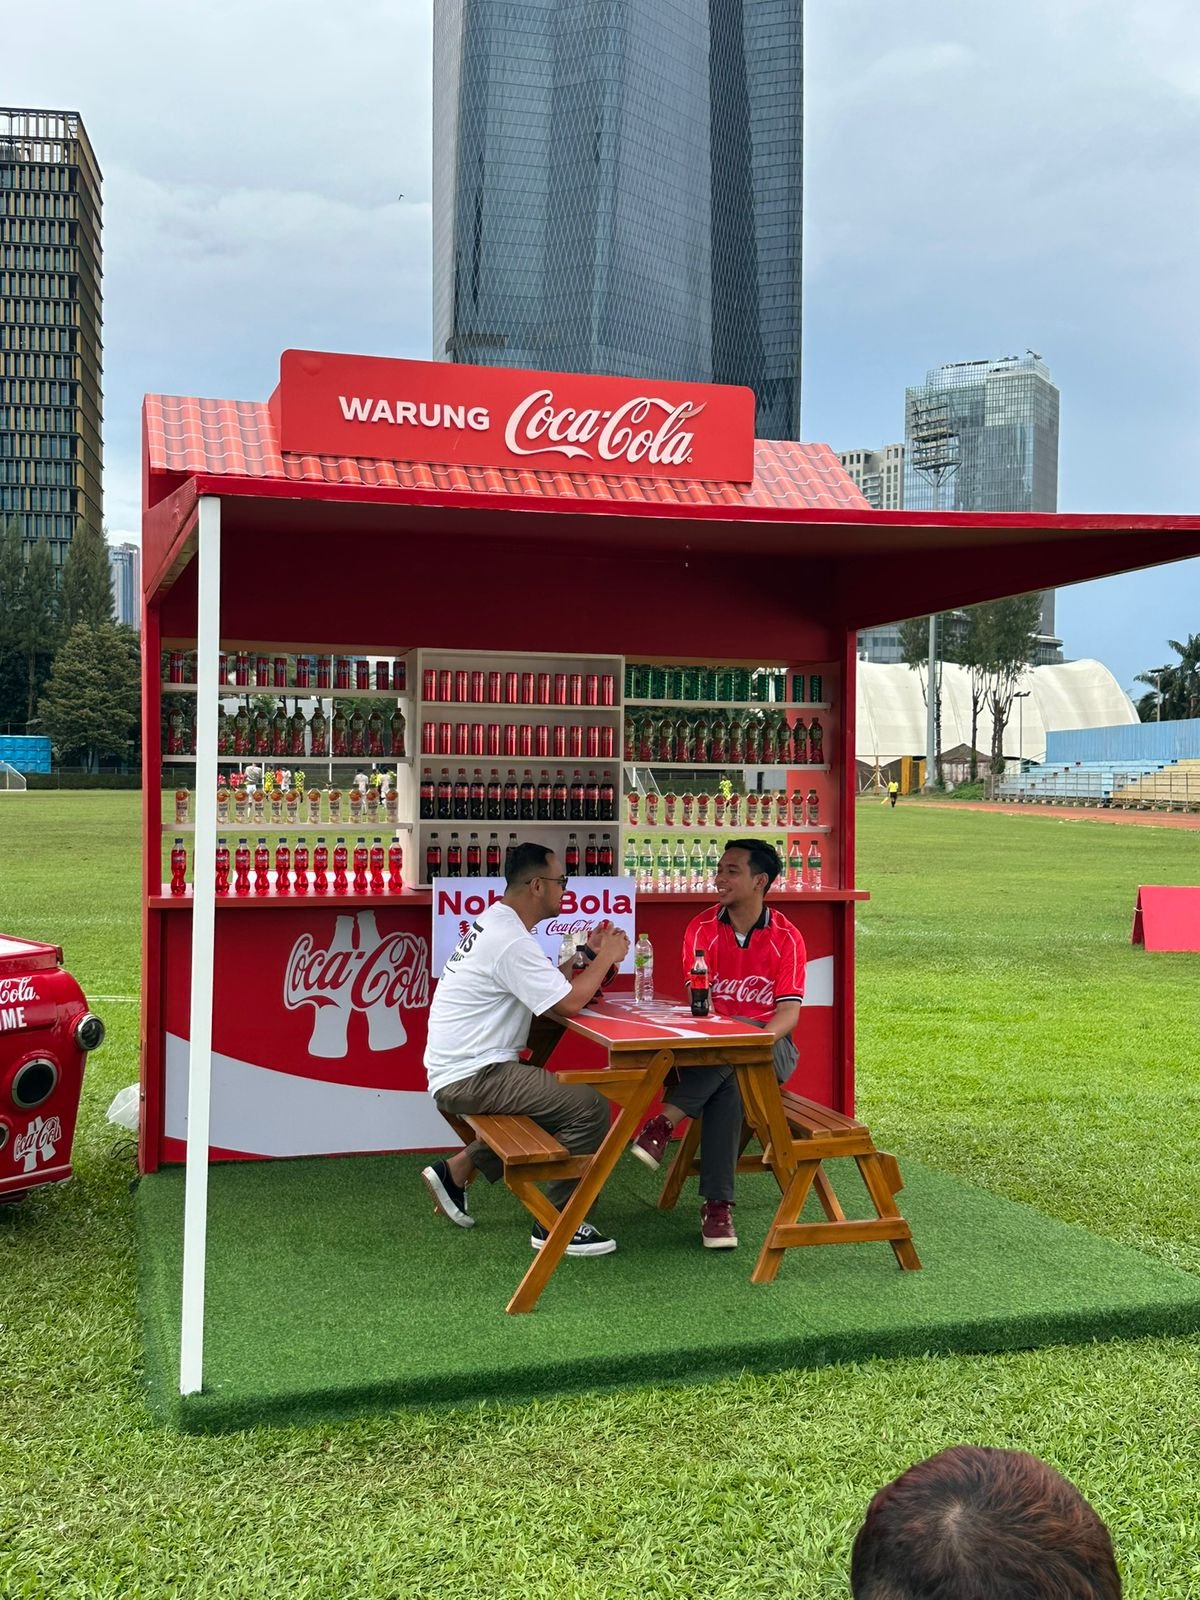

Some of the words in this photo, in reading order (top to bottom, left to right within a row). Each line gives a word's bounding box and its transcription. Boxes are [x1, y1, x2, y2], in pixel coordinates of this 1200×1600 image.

[338, 395, 490, 431] WARUNG
[505, 389, 708, 466] Coca-Cola
[559, 889, 633, 915] Bola
[0, 1006, 27, 1031] ME
